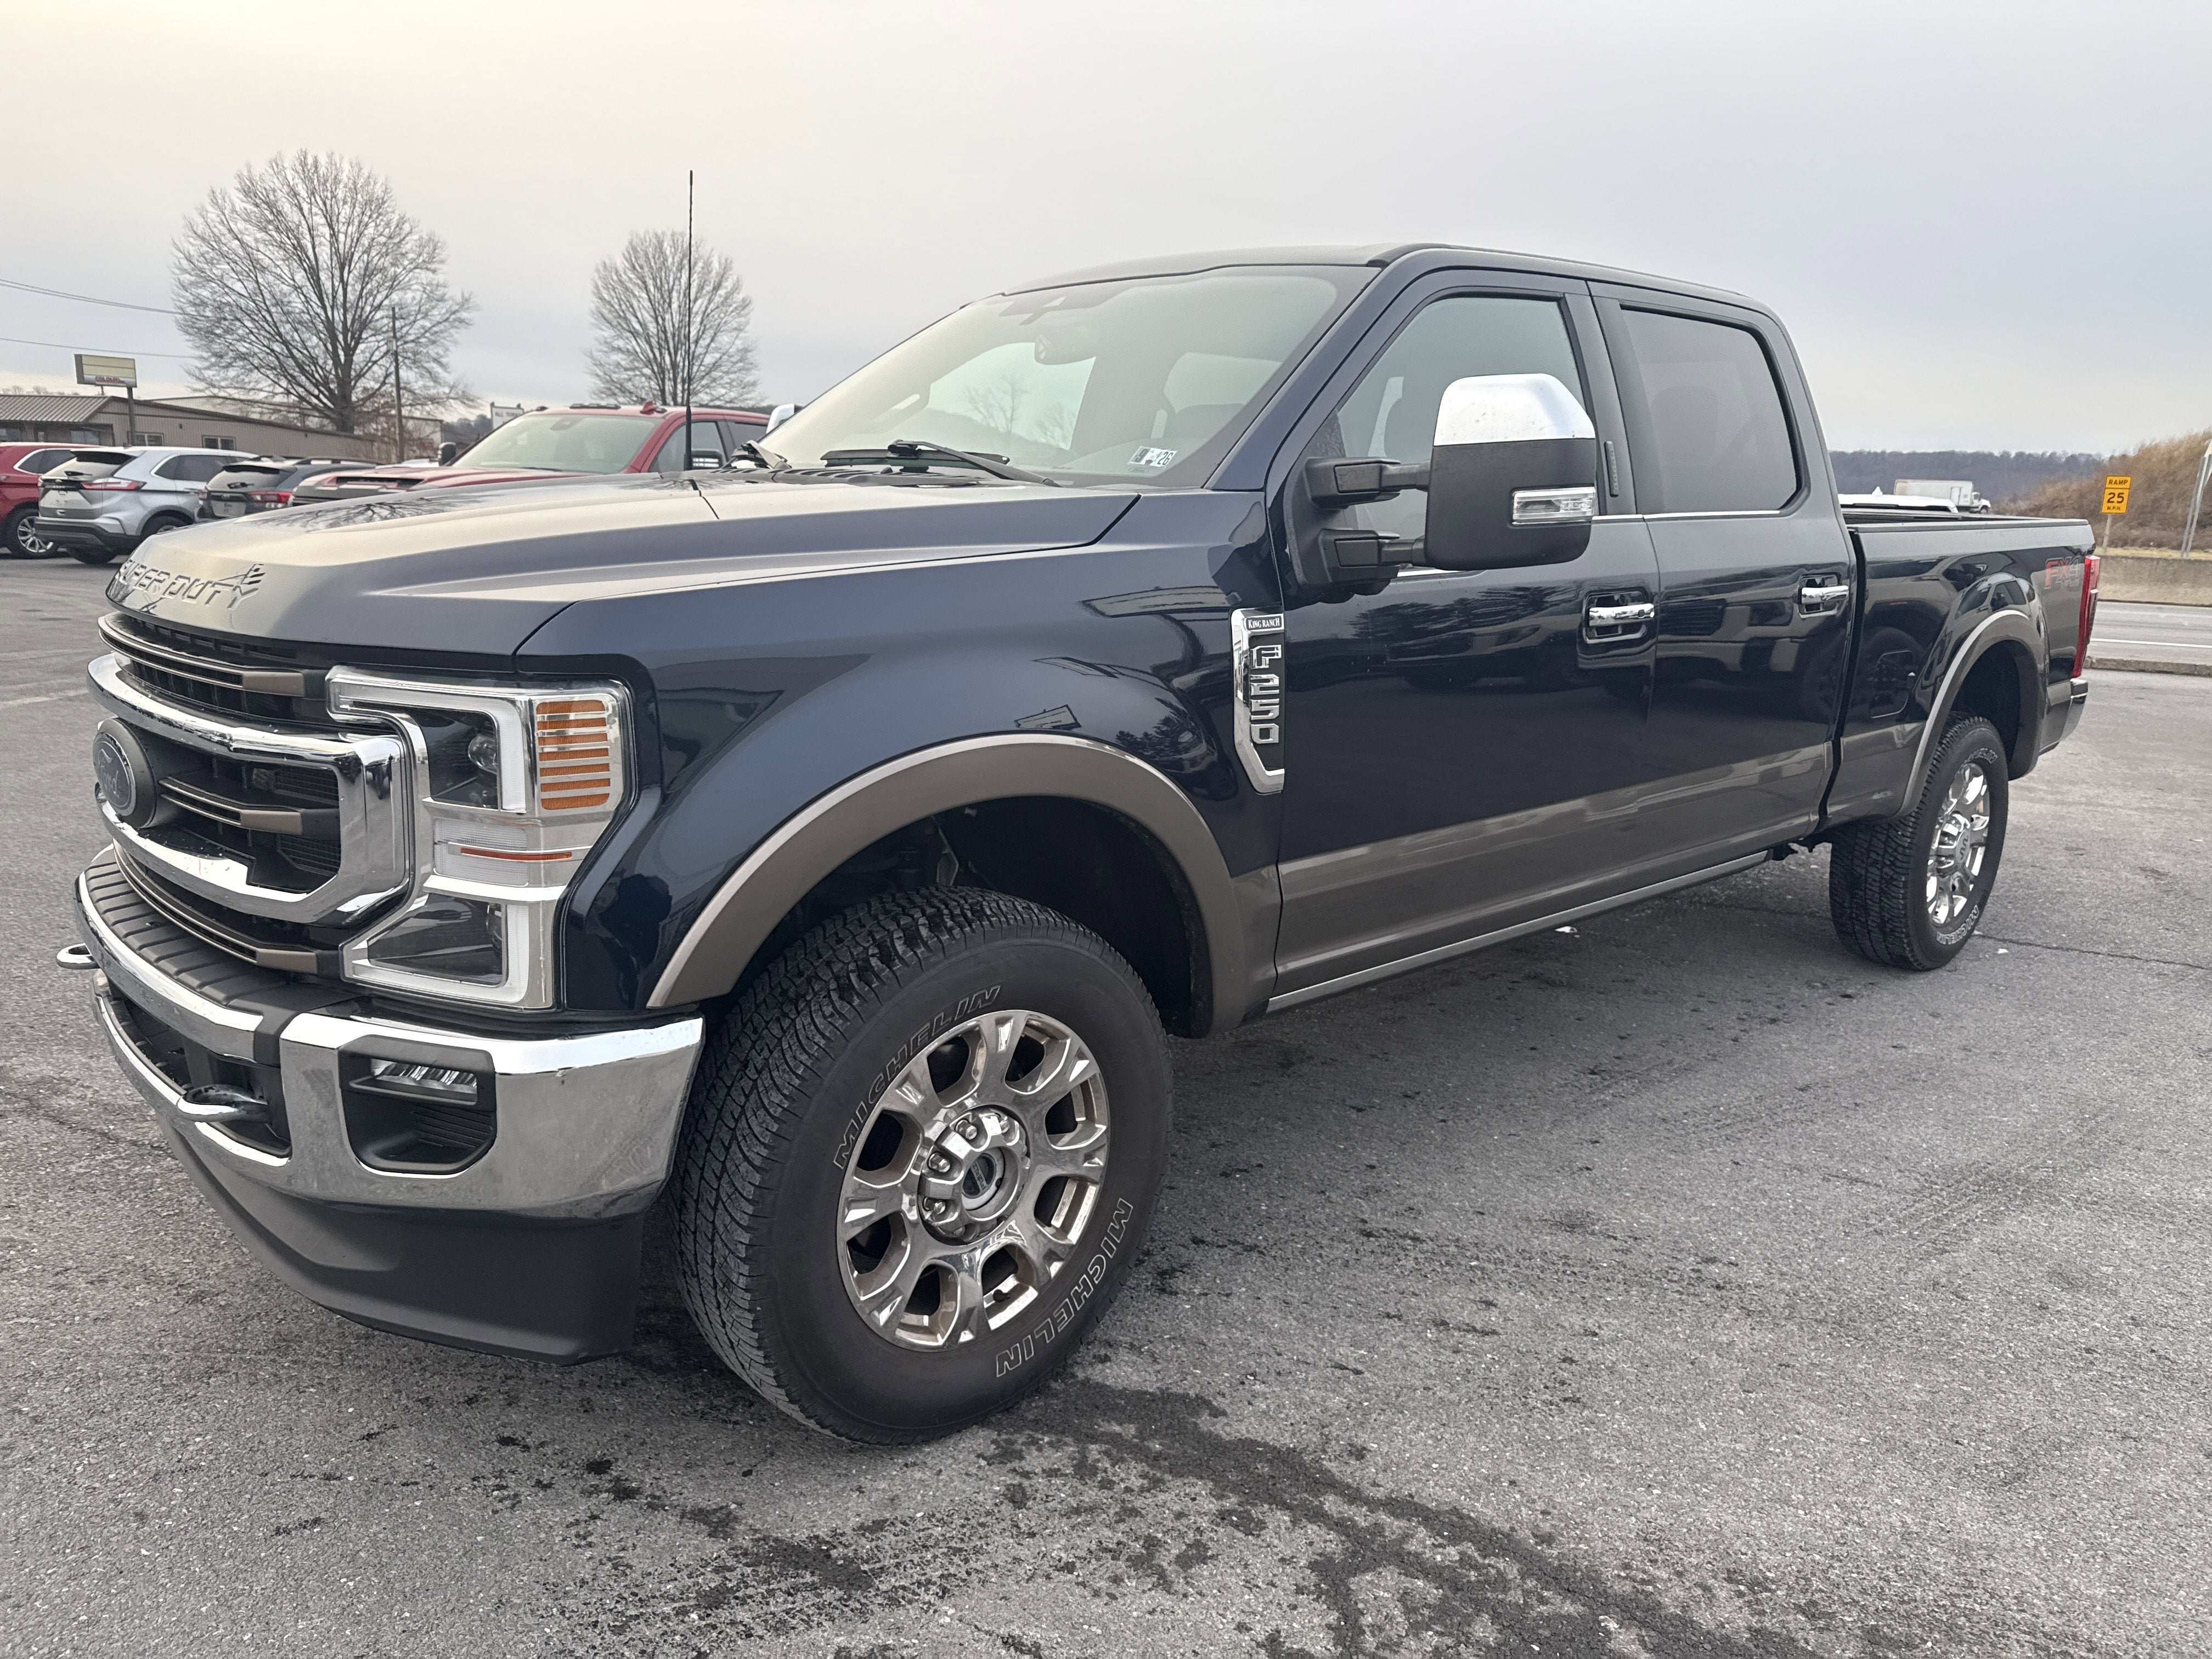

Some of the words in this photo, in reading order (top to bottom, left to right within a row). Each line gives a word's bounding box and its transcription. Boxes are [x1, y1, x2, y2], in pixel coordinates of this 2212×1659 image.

[1157, 451, 1174, 465] 26
[2107, 492, 2124, 504] 25
[2044, 555, 2081, 589] FX4
[161, 574, 259, 610] DUTY
[1248, 619, 1262, 629] KING
[1262, 617, 1280, 628] RANCH
[1250, 644, 1282, 744] F250
[1936, 904, 1979, 945] MICHELIN
[833, 985, 1001, 1170] MICHELIN
[996, 1198, 1133, 1378] MICHELIN
